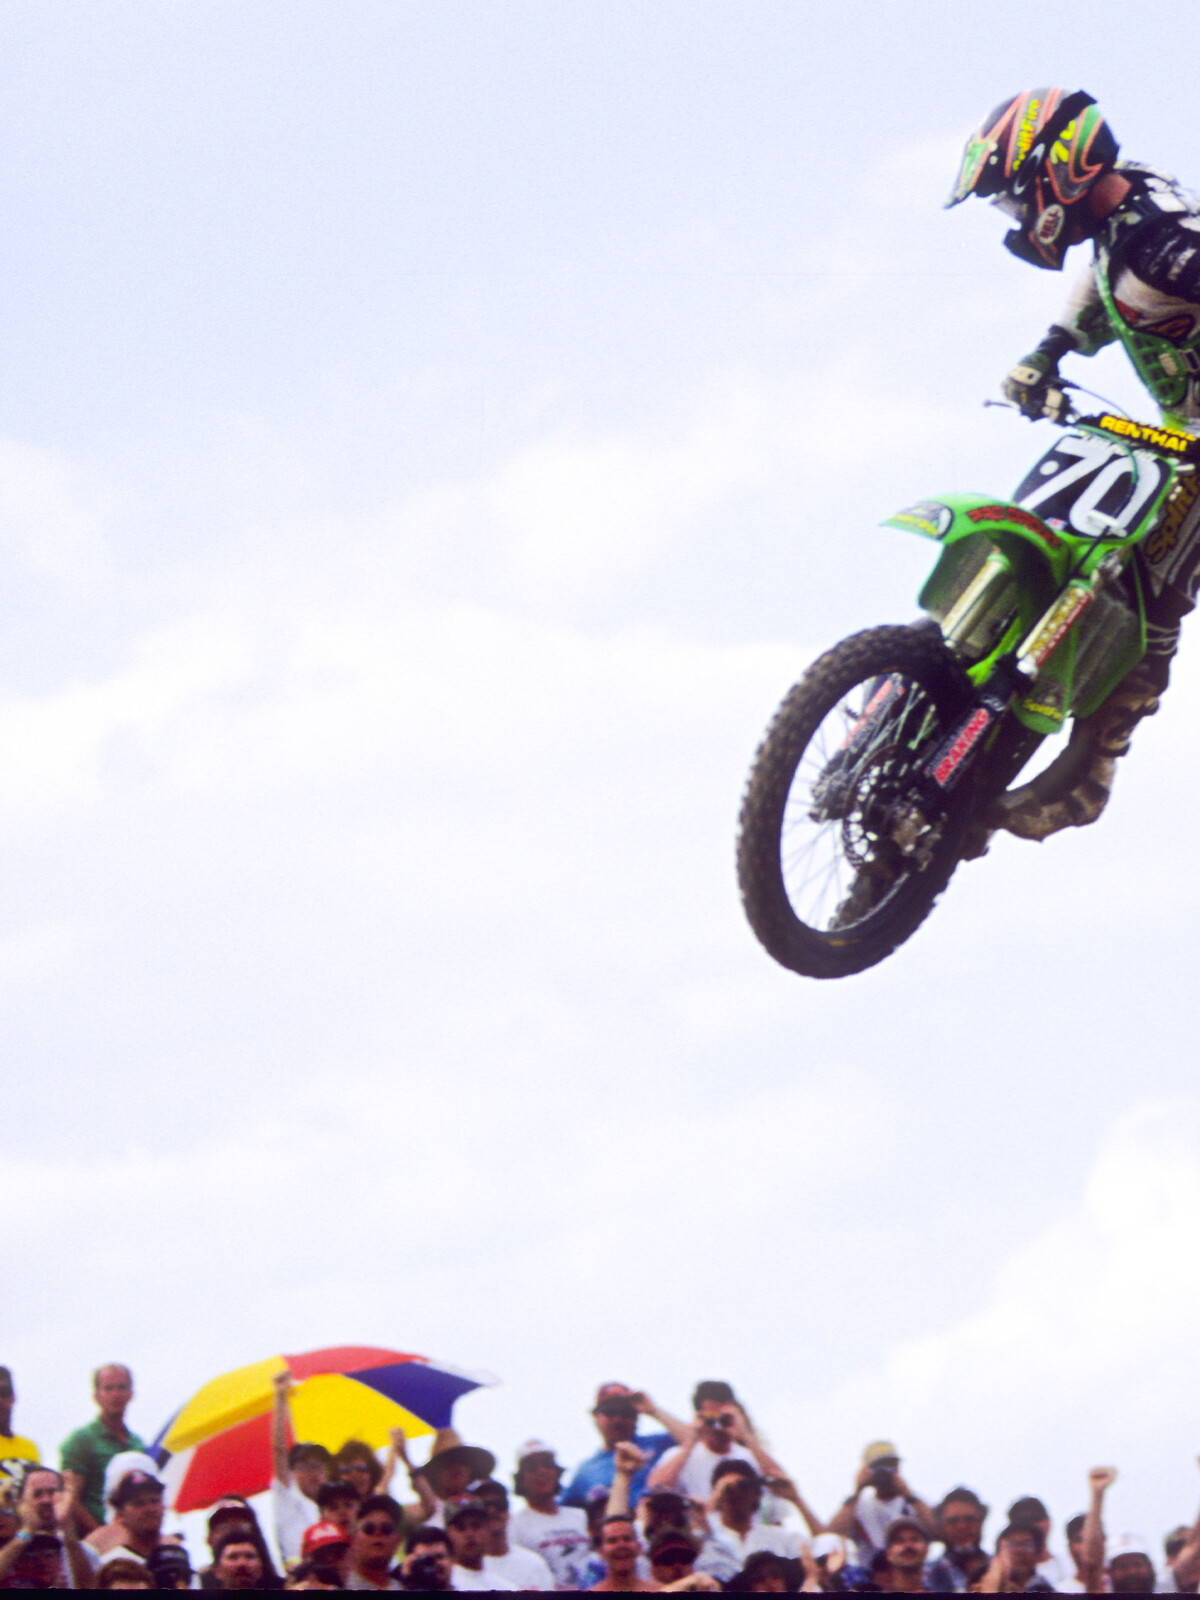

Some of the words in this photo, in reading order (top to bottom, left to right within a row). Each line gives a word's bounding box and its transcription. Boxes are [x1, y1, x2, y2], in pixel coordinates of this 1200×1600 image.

[1038, 208, 1060, 239] BELL
[1019, 434, 1161, 537] 70
[932, 707, 990, 787] BRAKING
